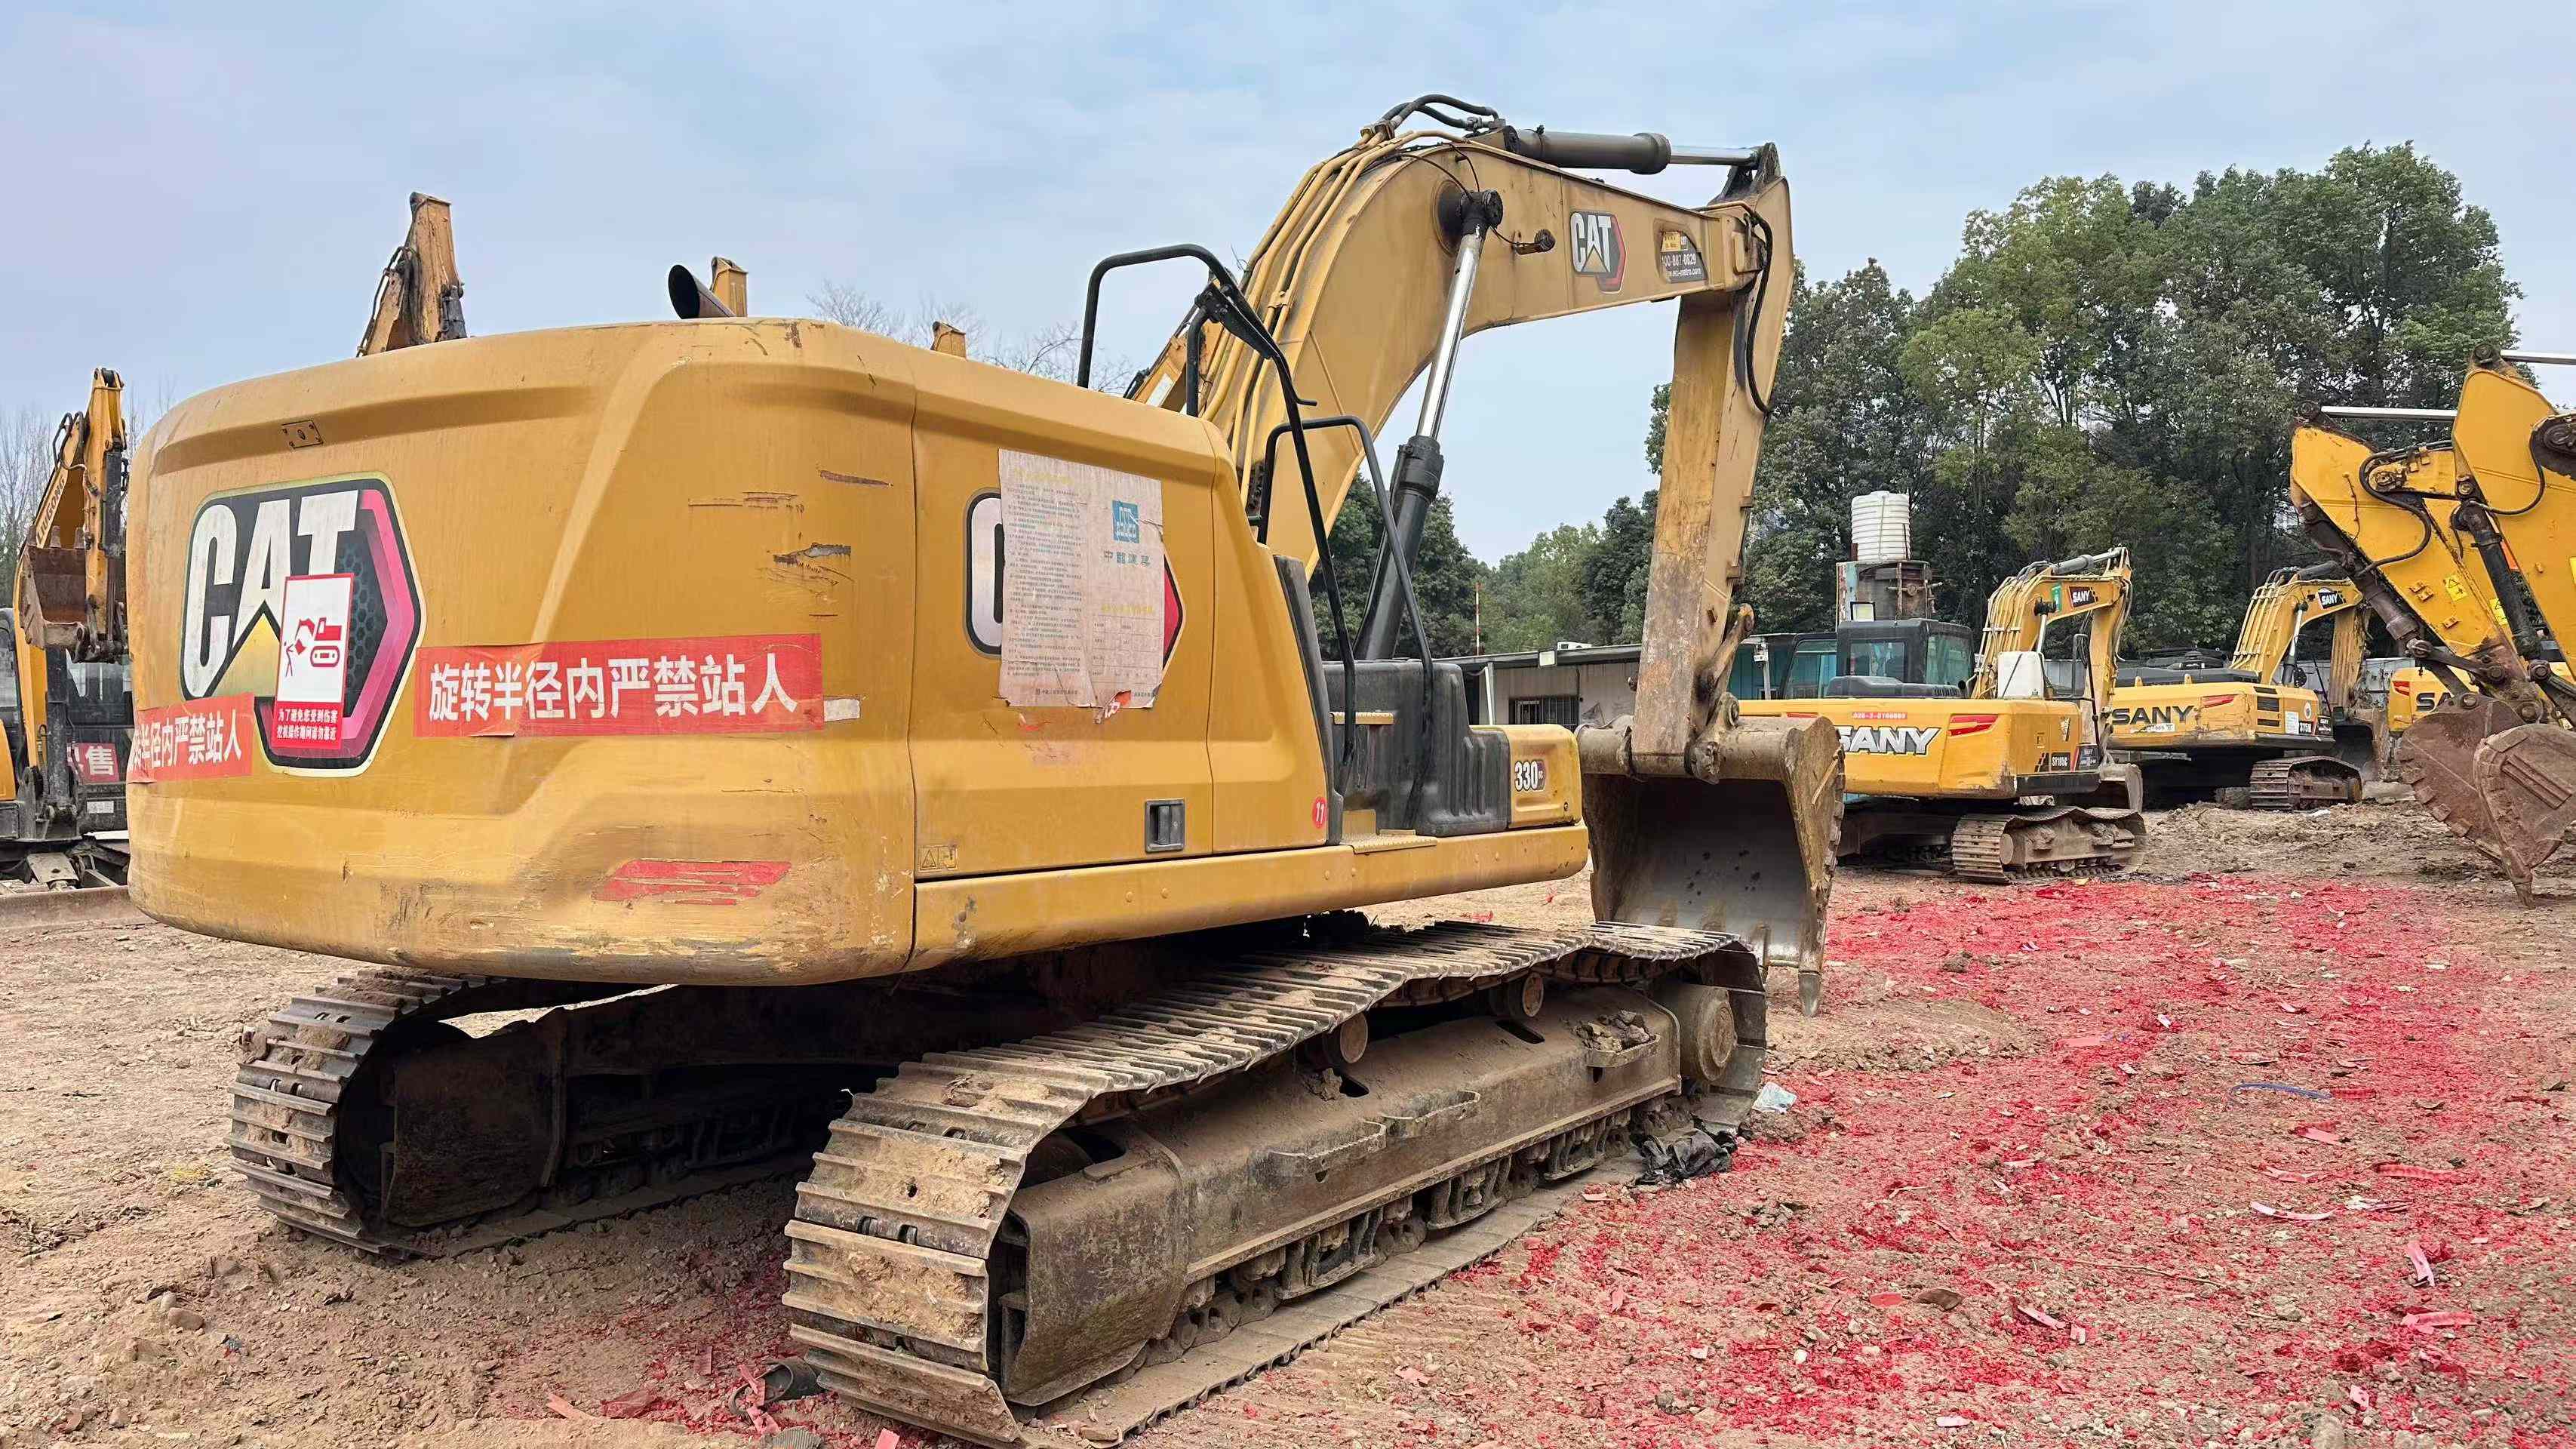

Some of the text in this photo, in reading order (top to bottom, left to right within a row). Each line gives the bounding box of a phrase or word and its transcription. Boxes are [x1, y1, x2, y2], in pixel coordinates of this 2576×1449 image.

[1570, 213, 1612, 272] CAT
[38, 475, 66, 540] LIUGONG
[183, 490, 358, 697] CAT
[2072, 590, 2090, 603] SANY
[2322, 593, 2338, 605] SANY
[429, 652, 798, 721] 旋转半径内严禁站人
[278, 708, 338, 723] 为了避免您受到伤害
[2113, 705, 2194, 724] SANY
[277, 724, 337, 741] 挖机操作期间请勿靠近
[1834, 725, 1941, 755] SANY
[1514, 760, 1539, 792] 330
